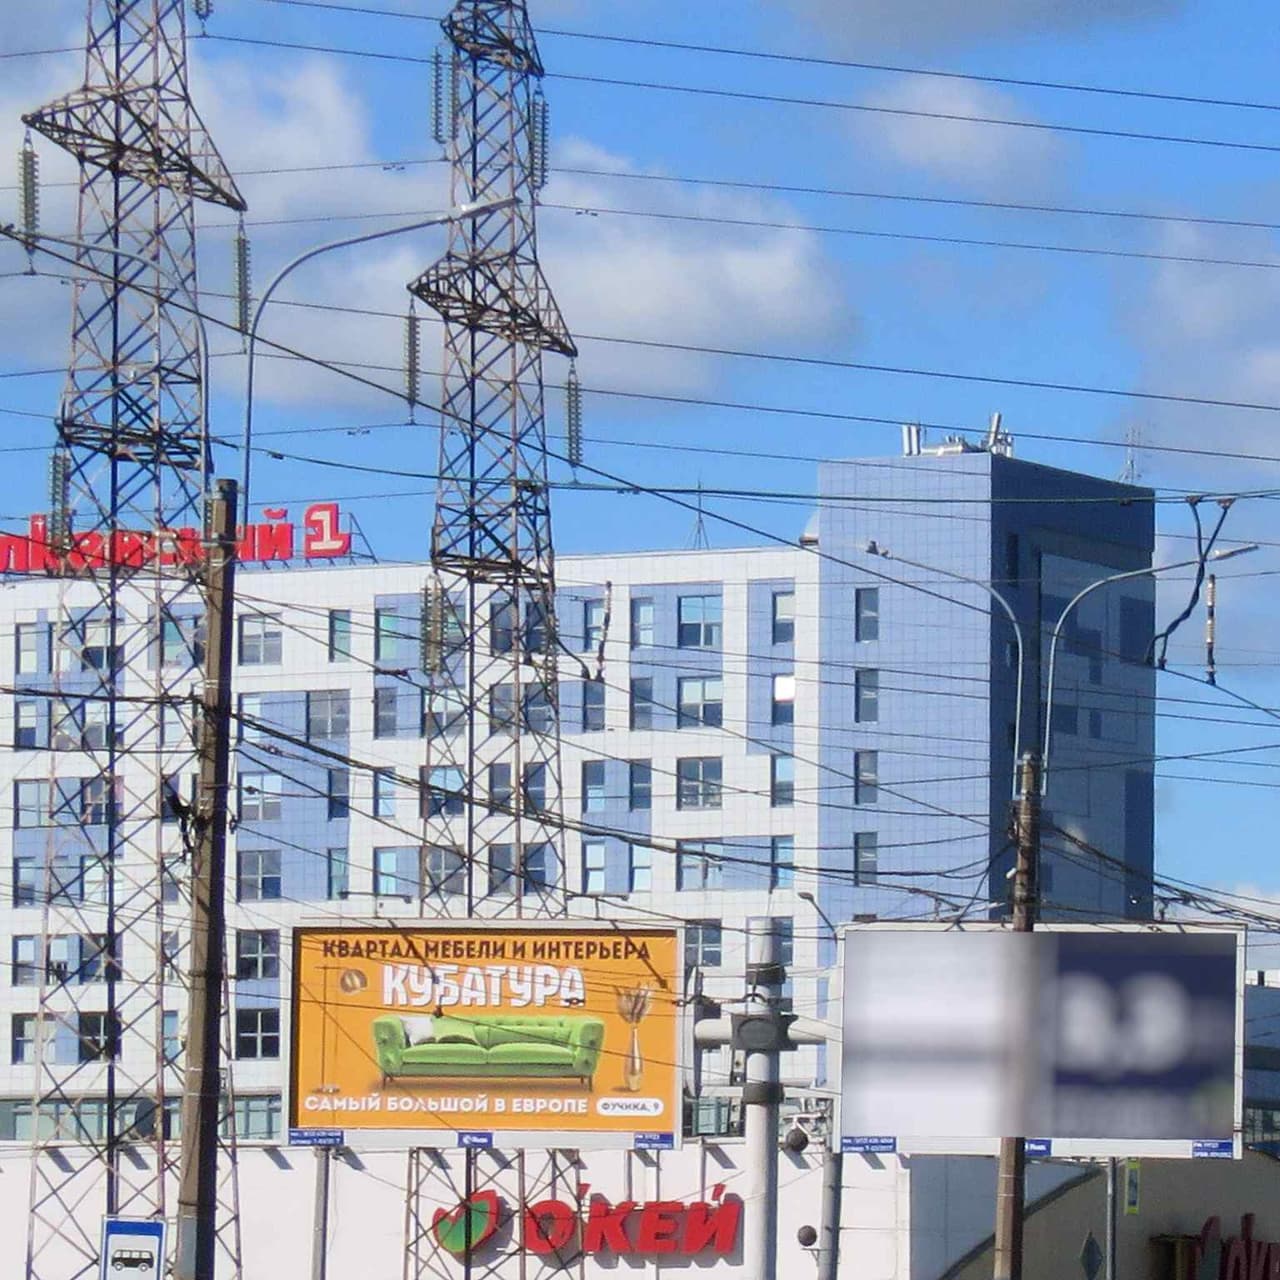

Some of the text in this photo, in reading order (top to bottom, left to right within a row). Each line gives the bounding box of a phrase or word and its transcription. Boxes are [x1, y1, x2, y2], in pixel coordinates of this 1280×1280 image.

[305, 503, 351, 557] 1
[323, 940, 651, 961] КВАРТАЛ МЕБЕЛИ И ИНТЕРЬЕРА
[382, 964, 586, 1008] КУБАТУРА
[304, 1094, 381, 1113] САМЫЙ
[387, 1093, 489, 1114] БОЛЬШОЙ
[494, 1098, 507, 1113] В
[512, 1098, 588, 1114] ЕВРОПЕ
